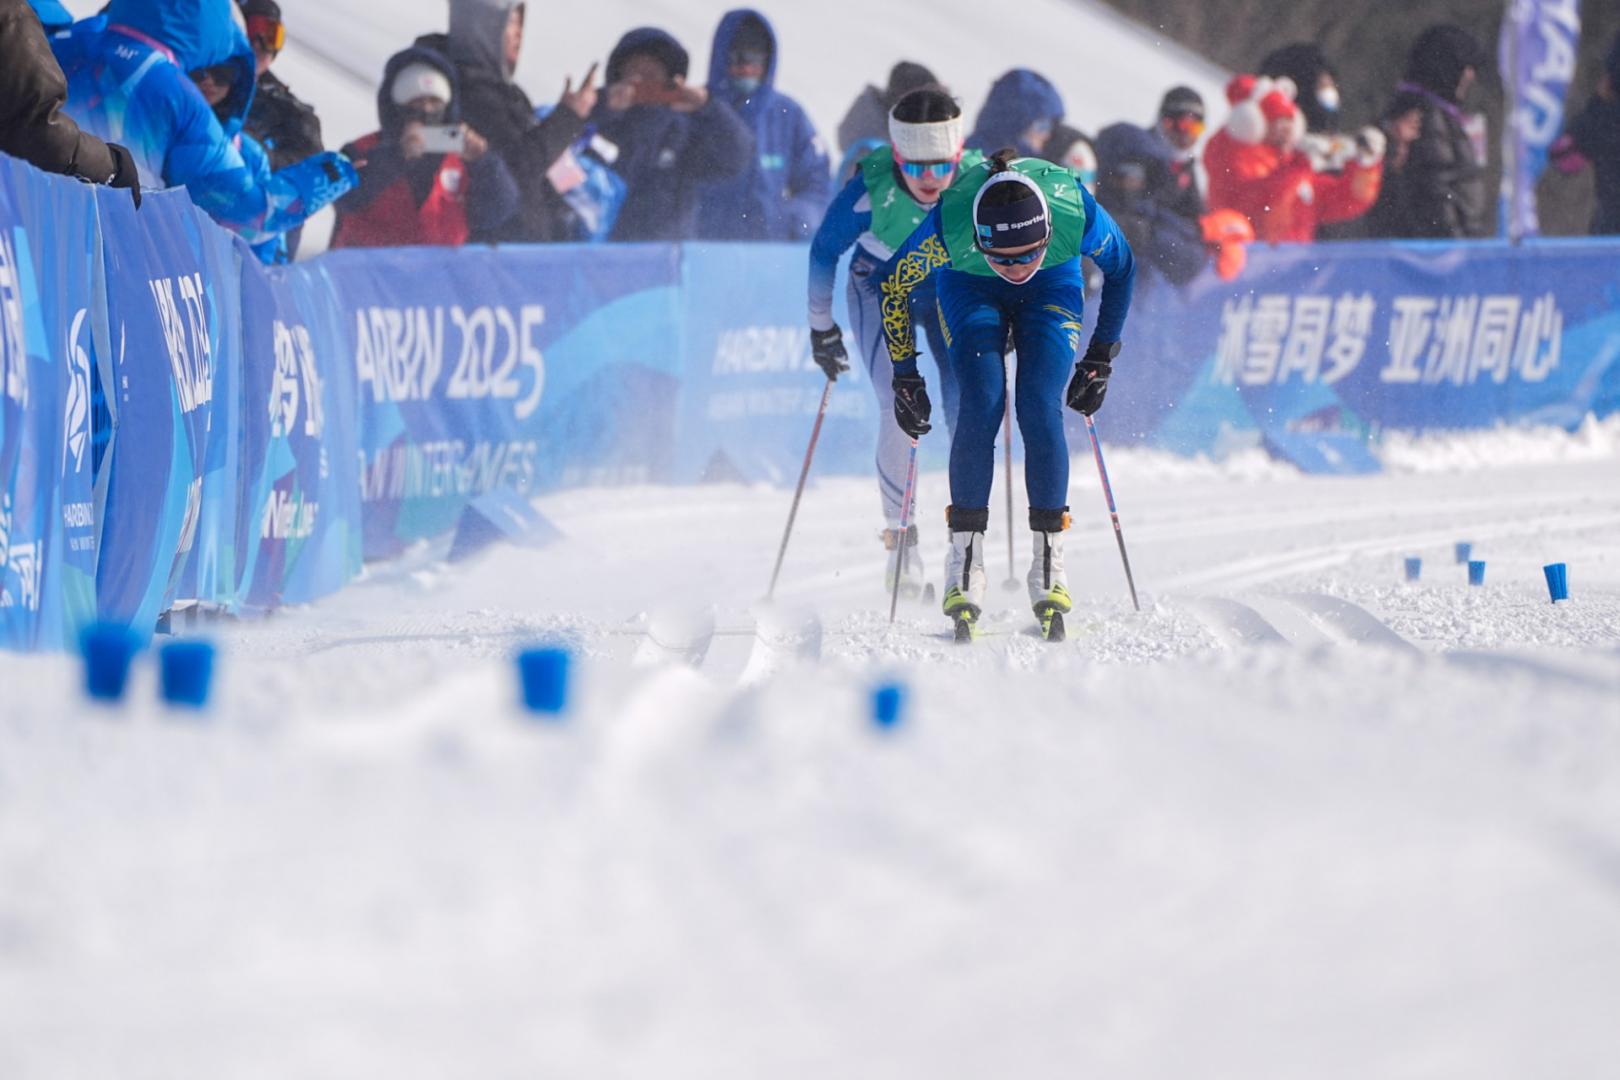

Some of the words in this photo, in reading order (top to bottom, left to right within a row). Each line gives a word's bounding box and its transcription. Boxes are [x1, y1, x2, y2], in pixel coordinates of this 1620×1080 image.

[446, 305, 546, 419] 2025
[1382, 294, 1562, 384] 亚洲同心
